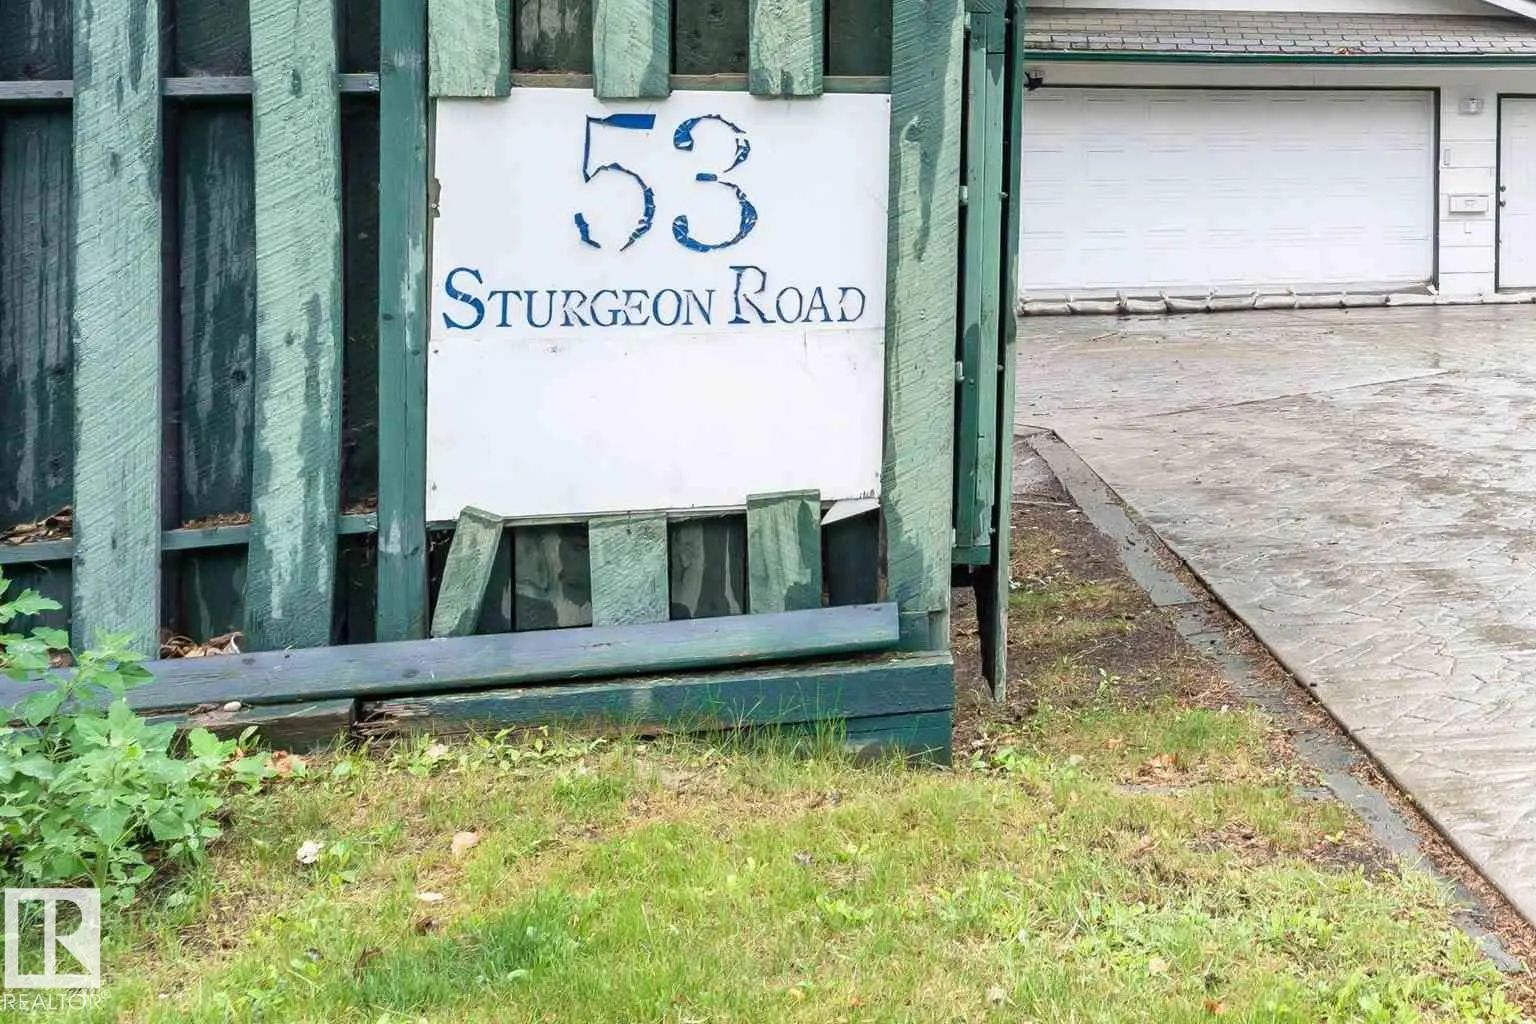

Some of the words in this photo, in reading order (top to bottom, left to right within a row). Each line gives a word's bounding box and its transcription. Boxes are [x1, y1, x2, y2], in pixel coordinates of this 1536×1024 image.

[573, 112, 759, 253] 53
[441, 266, 716, 330] STURGEON
[727, 265, 867, 325] ROAD
